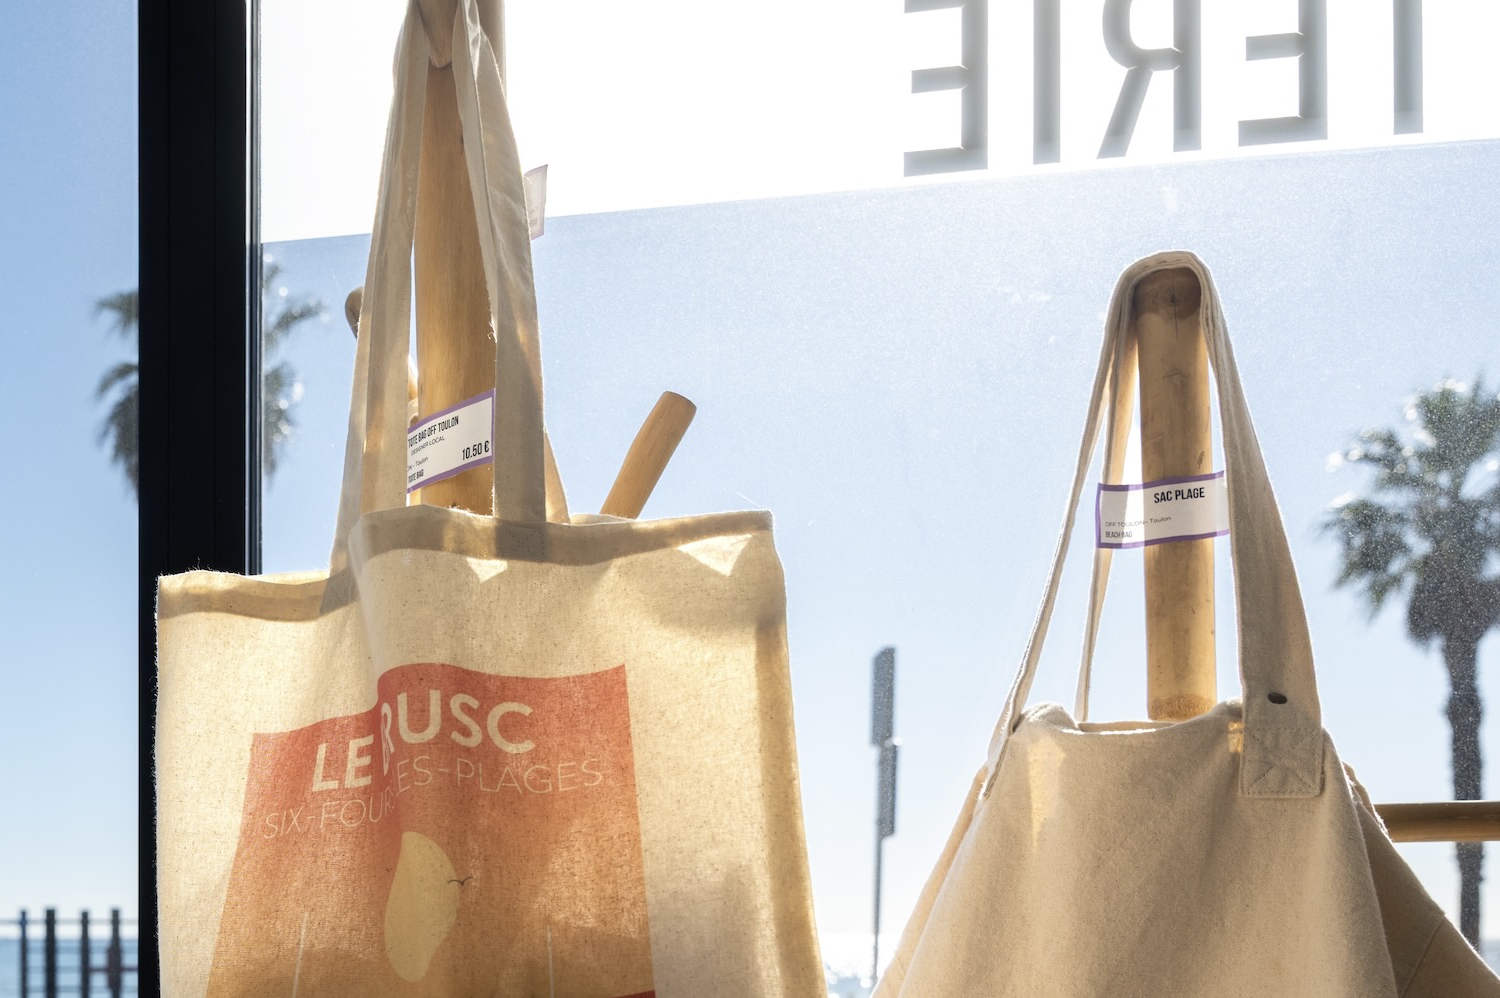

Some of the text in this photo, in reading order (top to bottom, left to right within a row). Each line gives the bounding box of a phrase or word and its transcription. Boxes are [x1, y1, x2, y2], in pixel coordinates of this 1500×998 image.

[408, 415, 459, 448] TOTE BAG OFF TOULON
[429, 436, 445, 446] LOCAL
[462, 440, 490, 461] 10.50 €
[1154, 487, 1205, 504] SAC PLAGE
[1149, 516, 1172, 524] Toulon
[312, 734, 375, 793] LE
